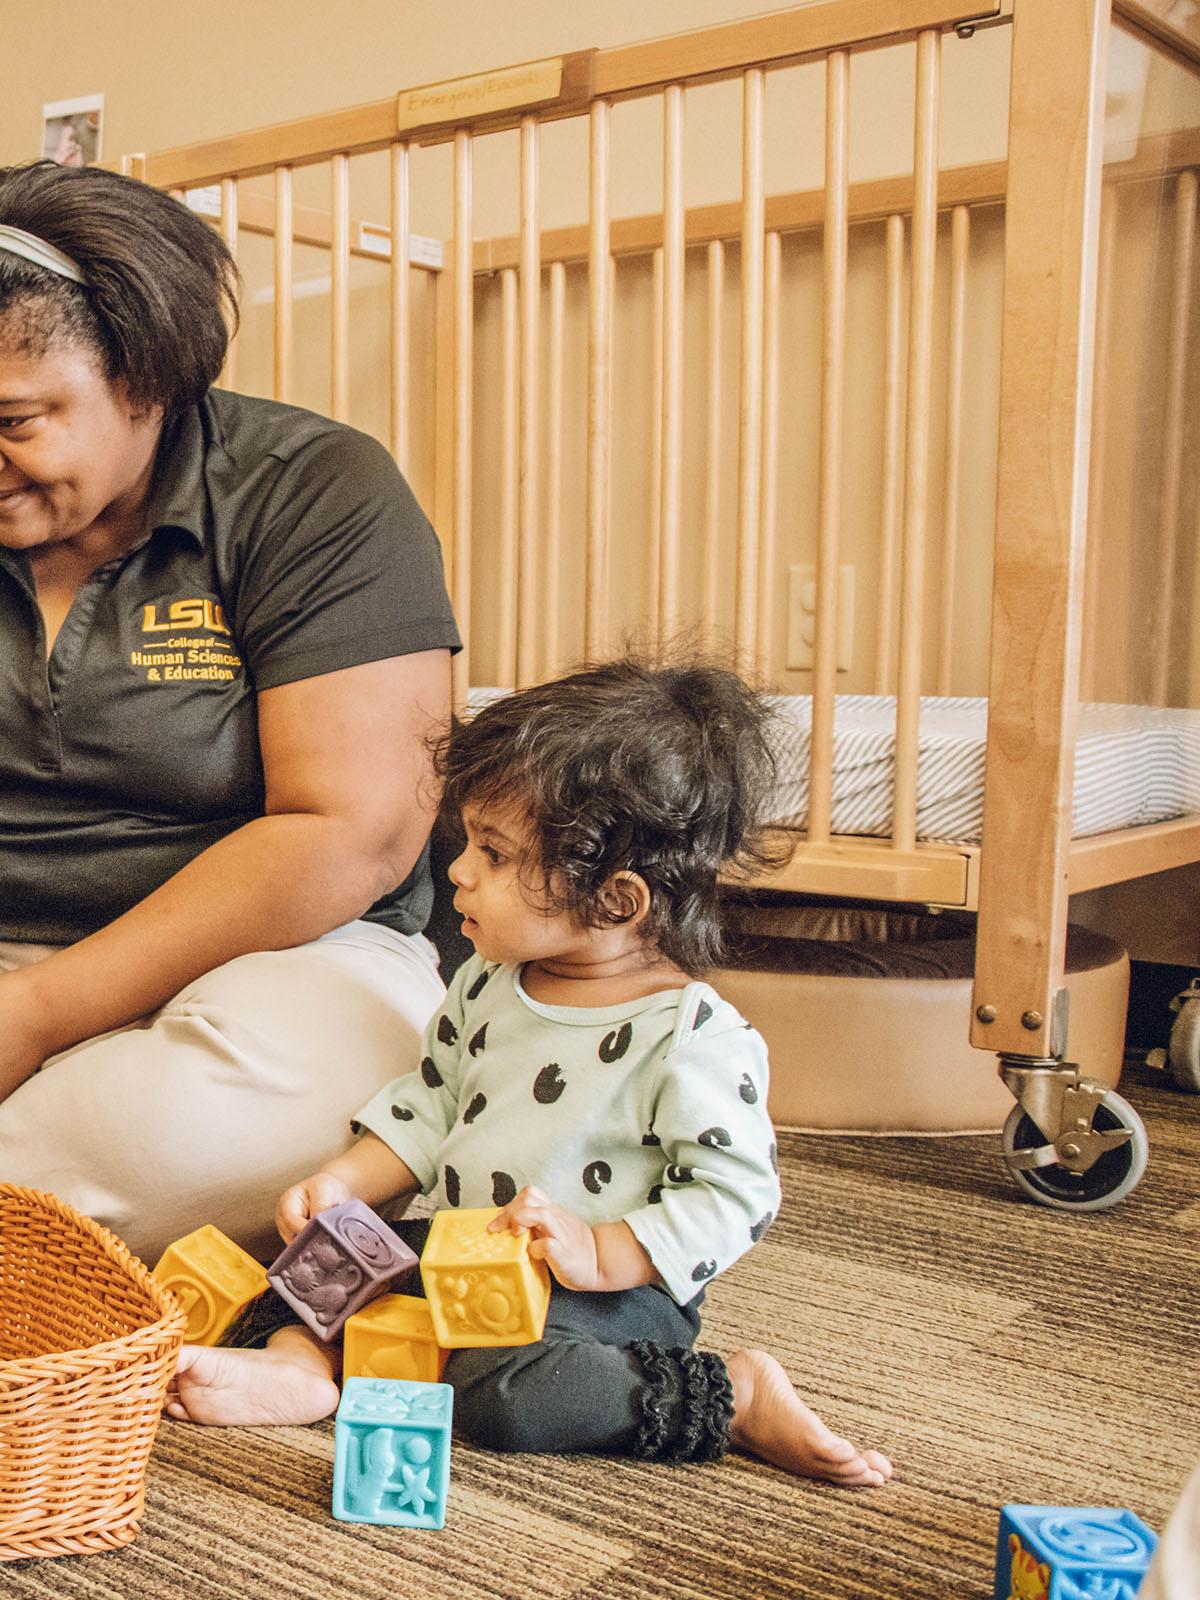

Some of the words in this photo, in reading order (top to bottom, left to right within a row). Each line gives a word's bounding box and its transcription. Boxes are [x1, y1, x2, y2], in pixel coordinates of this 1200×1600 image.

[142, 599, 230, 635] LSU
[167, 637, 205, 649] College
[205, 637, 214, 647] of
[131, 652, 184, 666] Human
[187, 649, 241, 666] Sciences
[147, 668, 161, 681] &
[164, 666, 234, 681] Education
